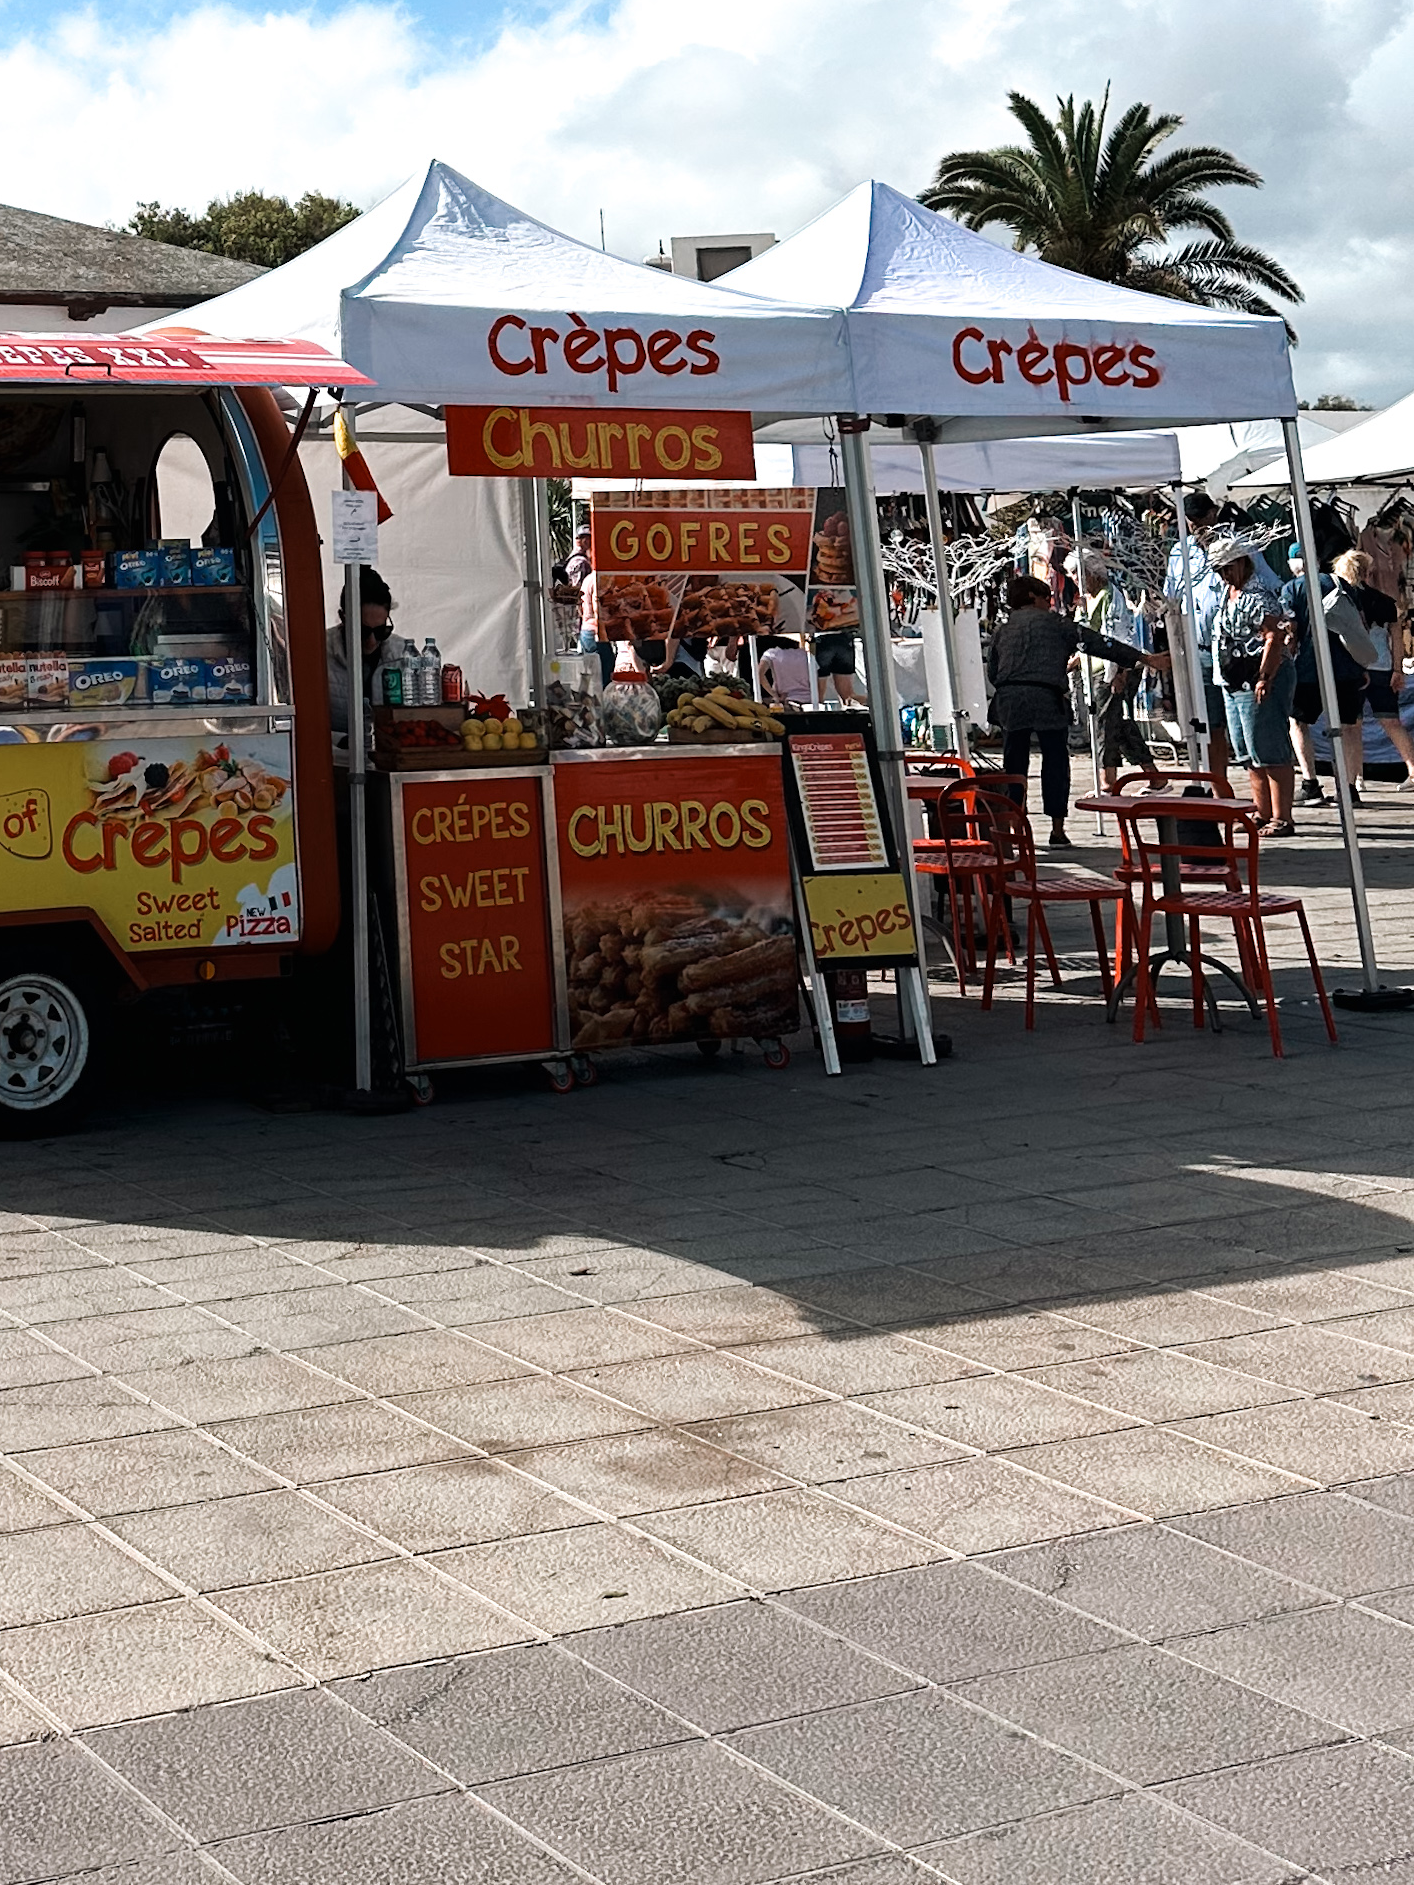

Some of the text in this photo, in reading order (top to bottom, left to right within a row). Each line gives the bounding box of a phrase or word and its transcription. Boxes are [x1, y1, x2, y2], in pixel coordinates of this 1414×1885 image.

[97, 347, 192, 367] XXL
[488, 312, 720, 393] Crèpes
[953, 321, 1161, 402] Crèpes
[482, 407, 723, 471] Churros
[610, 520, 792, 564] GOFRES
[29, 661, 67, 672] nutella
[75, 671, 123, 690] OREO
[160, 664, 199, 680] OREO
[213, 662, 250, 678] OREO
[3, 798, 38, 839] of
[411, 794, 531, 844] CRÉPES
[568, 800, 772, 857] CHURROS
[137, 887, 220, 915] Sweet
[420, 867, 529, 912] SWEET
[226, 915, 291, 937] Pizza
[246, 908, 266, 917] NEW
[129, 918, 203, 943] Salted
[440, 935, 523, 980] STAR
